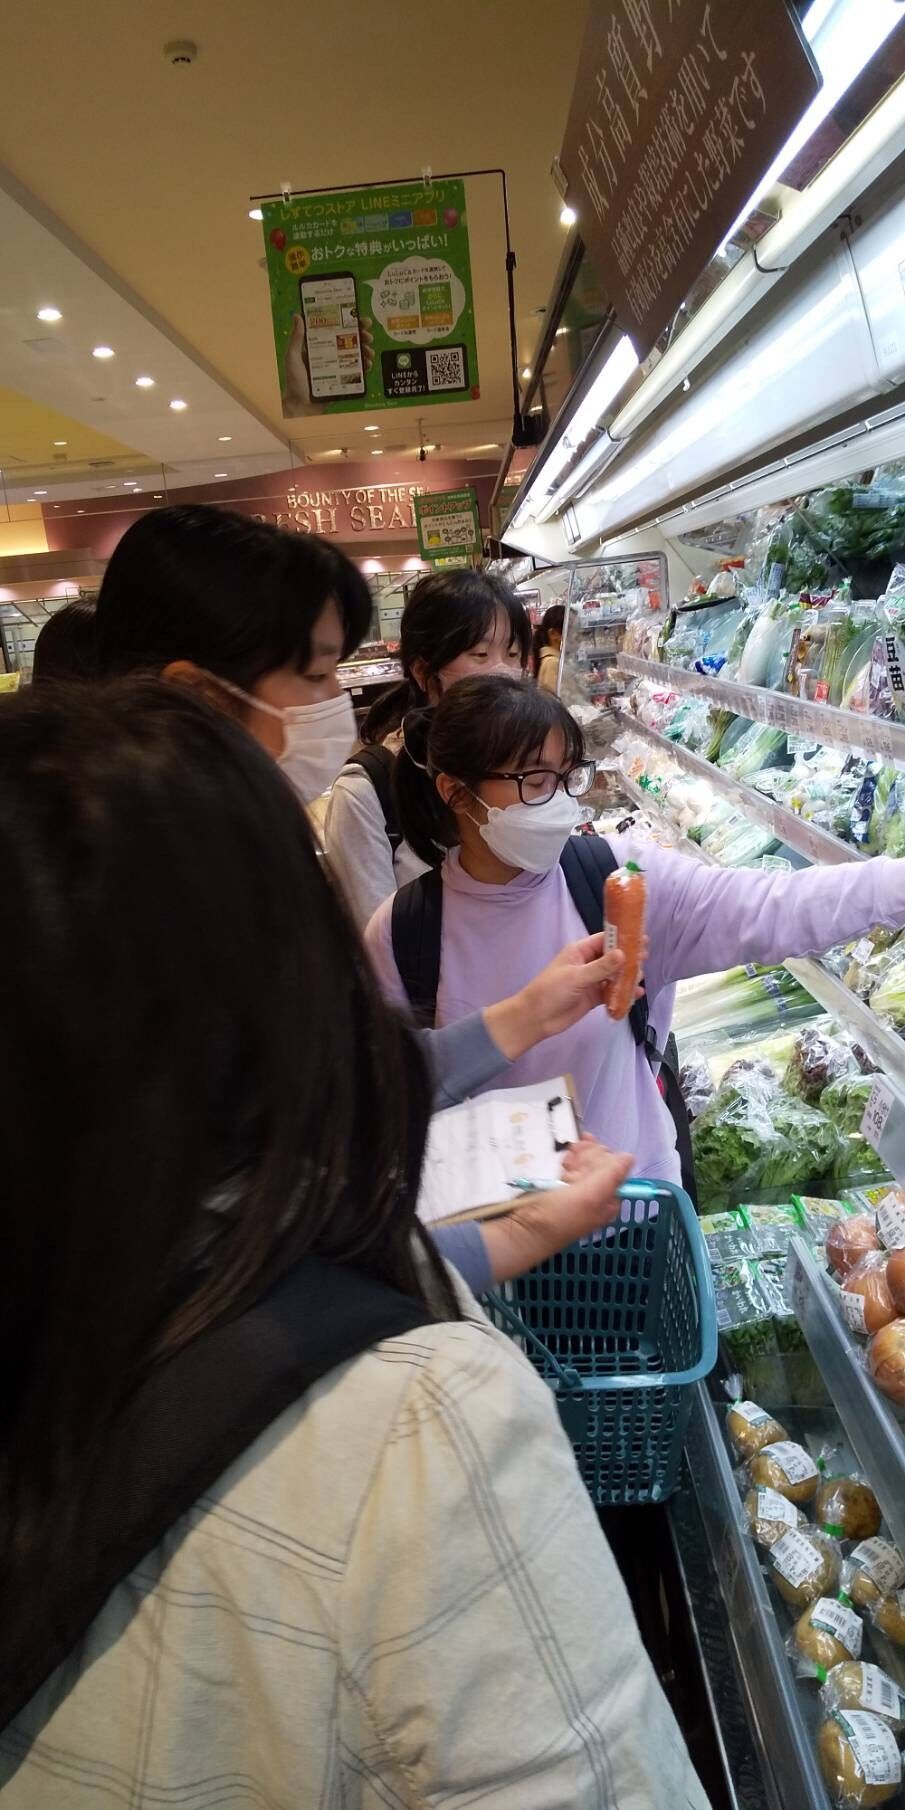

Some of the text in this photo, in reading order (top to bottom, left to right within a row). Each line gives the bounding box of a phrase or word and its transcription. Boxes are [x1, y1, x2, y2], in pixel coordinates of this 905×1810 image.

[279, 188, 445, 220] しずてつストア LINEミニアプリ
[287, 489, 350, 508] BOUNTY
[356, 489, 375, 503] OF
[380, 487, 405, 502] THE
[885, 635, 905, 691] 豆苗
